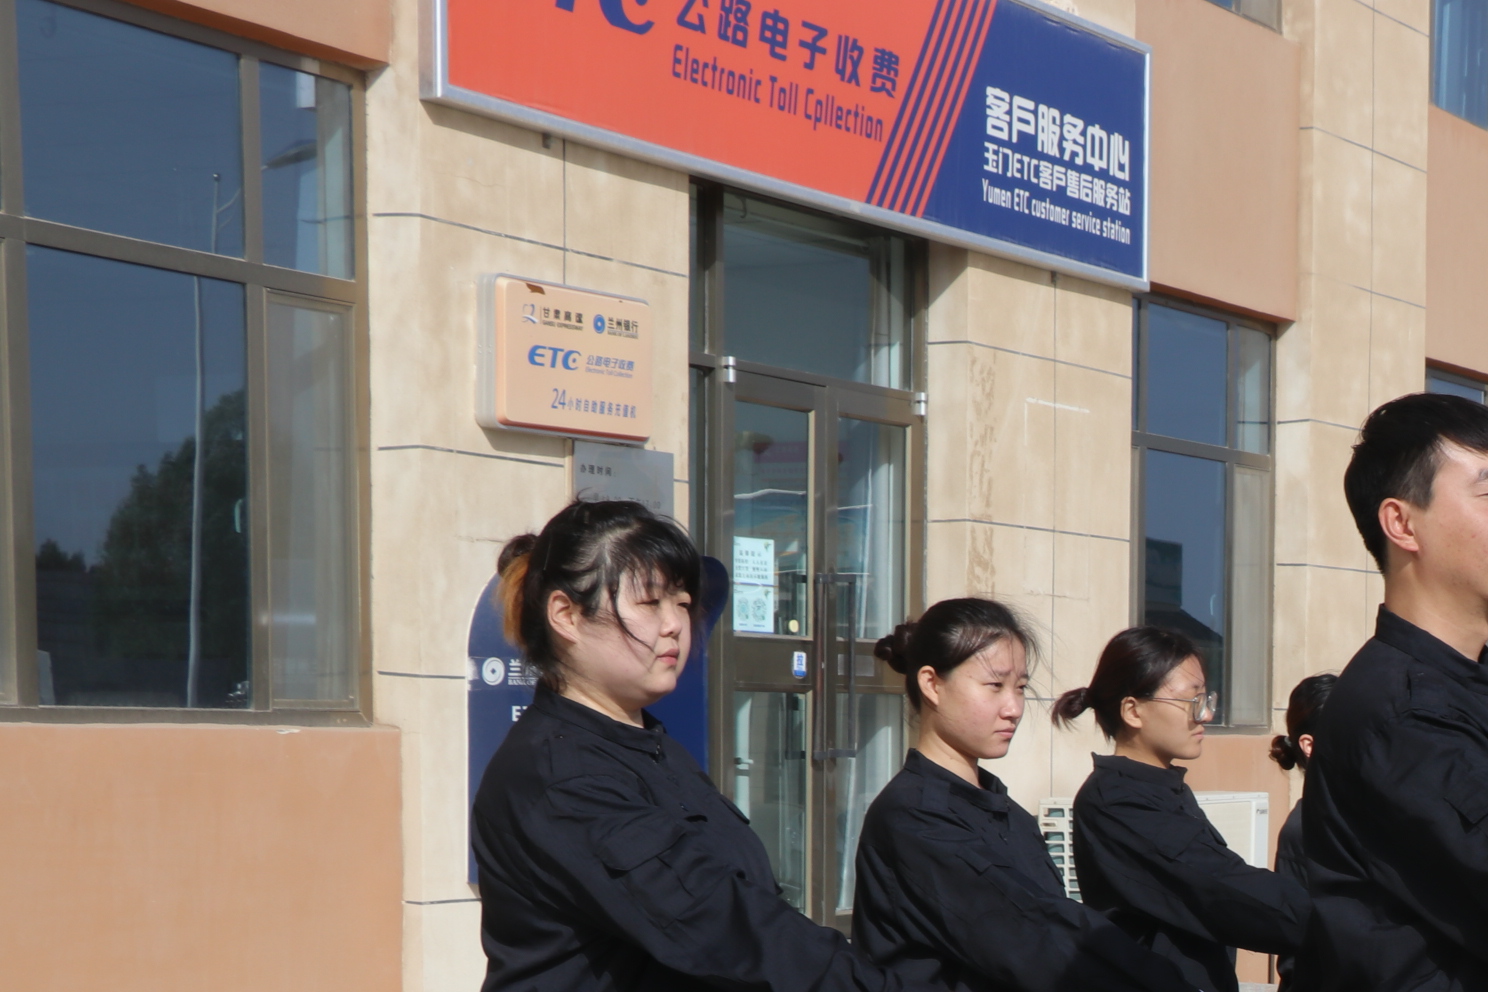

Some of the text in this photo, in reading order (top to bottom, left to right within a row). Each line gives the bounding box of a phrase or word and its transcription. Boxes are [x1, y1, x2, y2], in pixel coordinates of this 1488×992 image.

[676, 0, 900, 98] 公路电子收费
[671, 43, 762, 104] Electronic
[768, 74, 798, 116] Toll
[985, 85, 1130, 182] 客户服务中心
[983, 141, 1131, 216] 玉门ETC客户售后服务站
[982, 178, 1131, 245] Yumen ETC customer service station
[542, 307, 584, 324] 甘肃高速
[607, 316, 639, 333] 兰州银行
[527, 344, 582, 371] ETC
[586, 354, 635, 371] 公路电子收费
[511, 705, 528, 722] E
